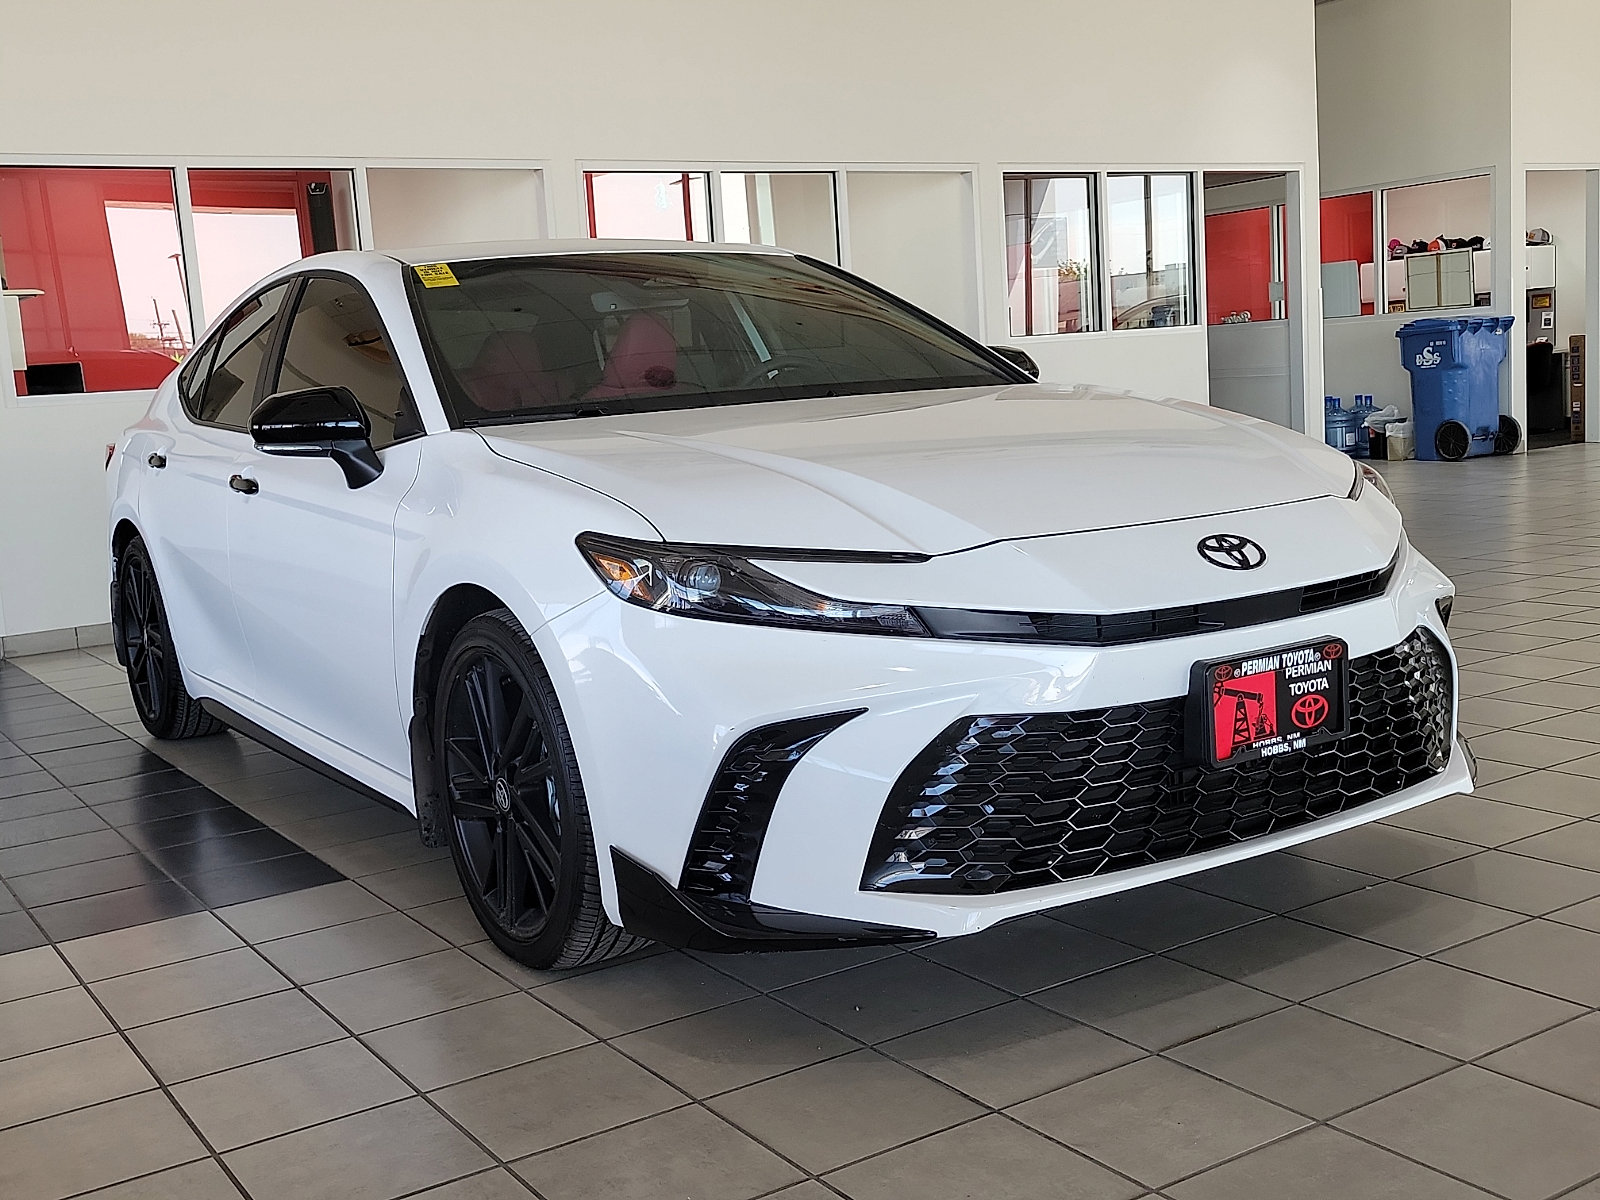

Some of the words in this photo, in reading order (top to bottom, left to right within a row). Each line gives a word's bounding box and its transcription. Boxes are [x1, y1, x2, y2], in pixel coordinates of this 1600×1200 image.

[1241, 655, 1280, 676] PERMIAN
[1285, 660, 1332, 680] PERMIAN
[1289, 677, 1329, 696] TOYOTA
[1261, 743, 1291, 757] HOBBS,
[1293, 738, 1307, 750] NM
